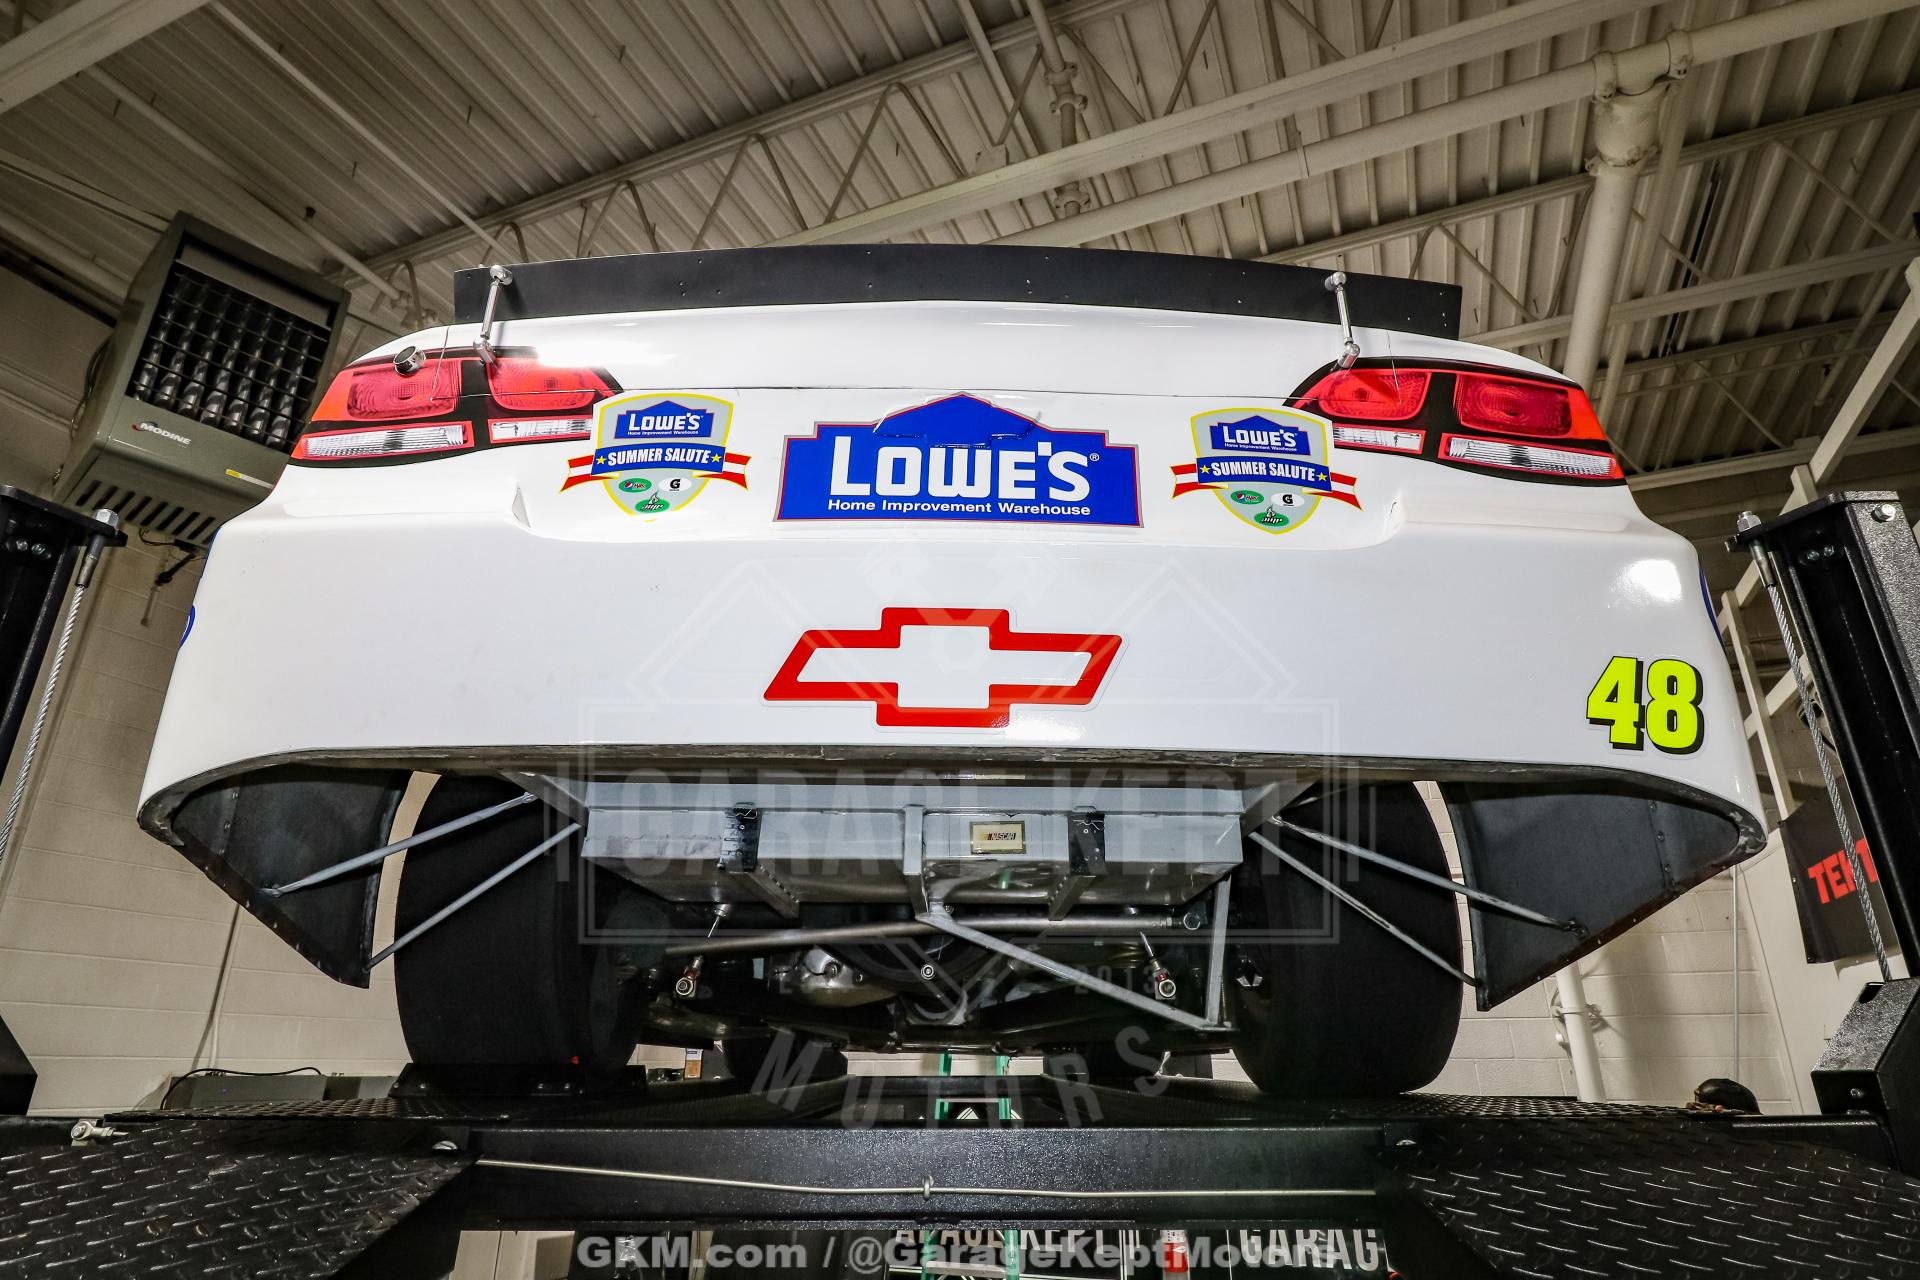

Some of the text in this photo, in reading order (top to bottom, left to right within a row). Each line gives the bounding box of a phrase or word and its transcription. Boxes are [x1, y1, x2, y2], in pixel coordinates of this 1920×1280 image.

[628, 412, 701, 431] LOWE'S
[139, 422, 192, 445] MODINE
[1222, 425, 1297, 448] LOWE'S
[607, 447, 711, 467] SUMMER SALUTE
[830, 435, 1091, 502] LOWE'S
[1210, 460, 1316, 482] SUMMER SALUTE
[827, 498, 1091, 516] Home Improvement Warehouse
[1586, 655, 1705, 755] 48
